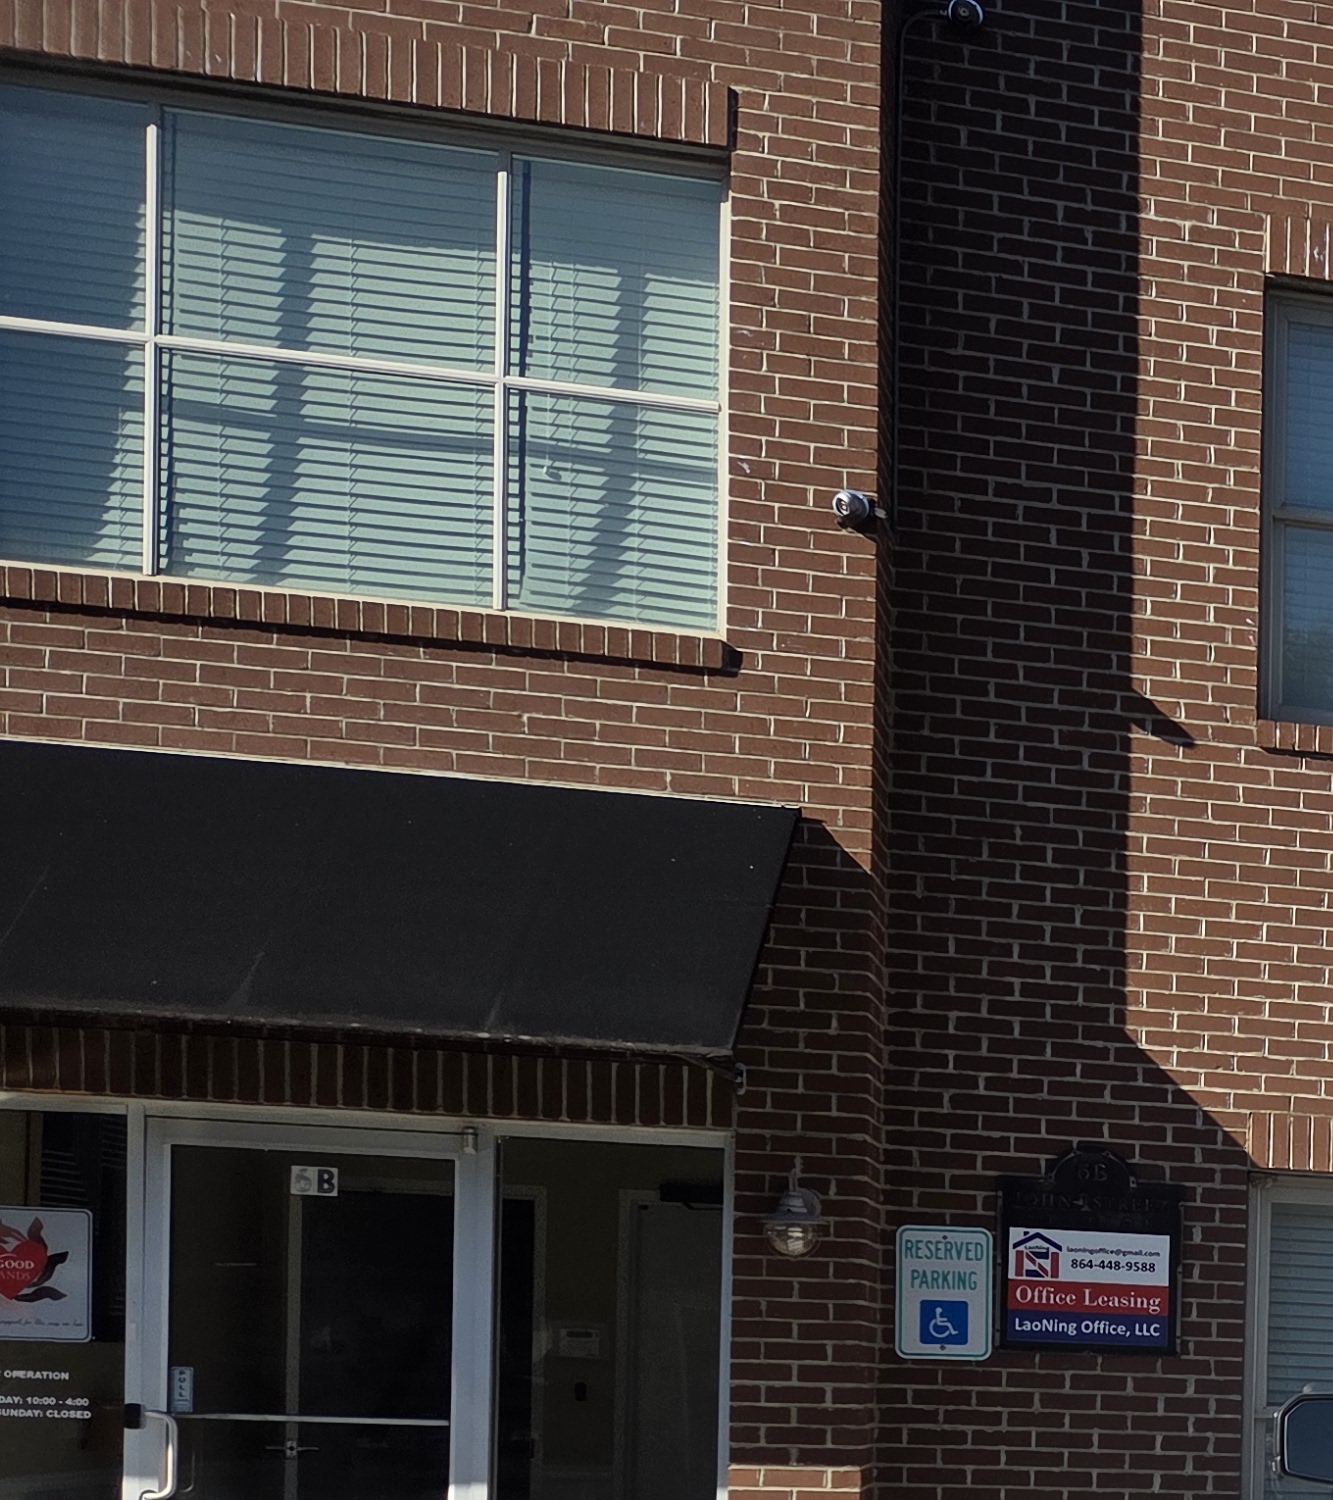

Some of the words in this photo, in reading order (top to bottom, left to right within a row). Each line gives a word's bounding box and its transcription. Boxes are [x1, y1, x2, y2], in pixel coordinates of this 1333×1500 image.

[294, 1168, 335, 1193] 6B
[904, 1239, 984, 1262] RESERVED
[1066, 1246, 1161, 1257] laoningoffice@gmail.com
[1071, 1259, 1156, 1273] 864-448-9588
[910, 1269, 978, 1291] PARKING
[1016, 1285, 1077, 1303] Office
[1083, 1289, 1161, 1315] Leasing
[1015, 1318, 1077, 1335] LaoNing
[1081, 1320, 1131, 1337] Office,
[1135, 1323, 1160, 1336] LLC
[4, 1370, 69, 1380] OPERATION
[26, 1397, 56, 1405] 10:00
[66, 1398, 89, 1406] 4:00
[46, 1410, 91, 1419] CLOSED
